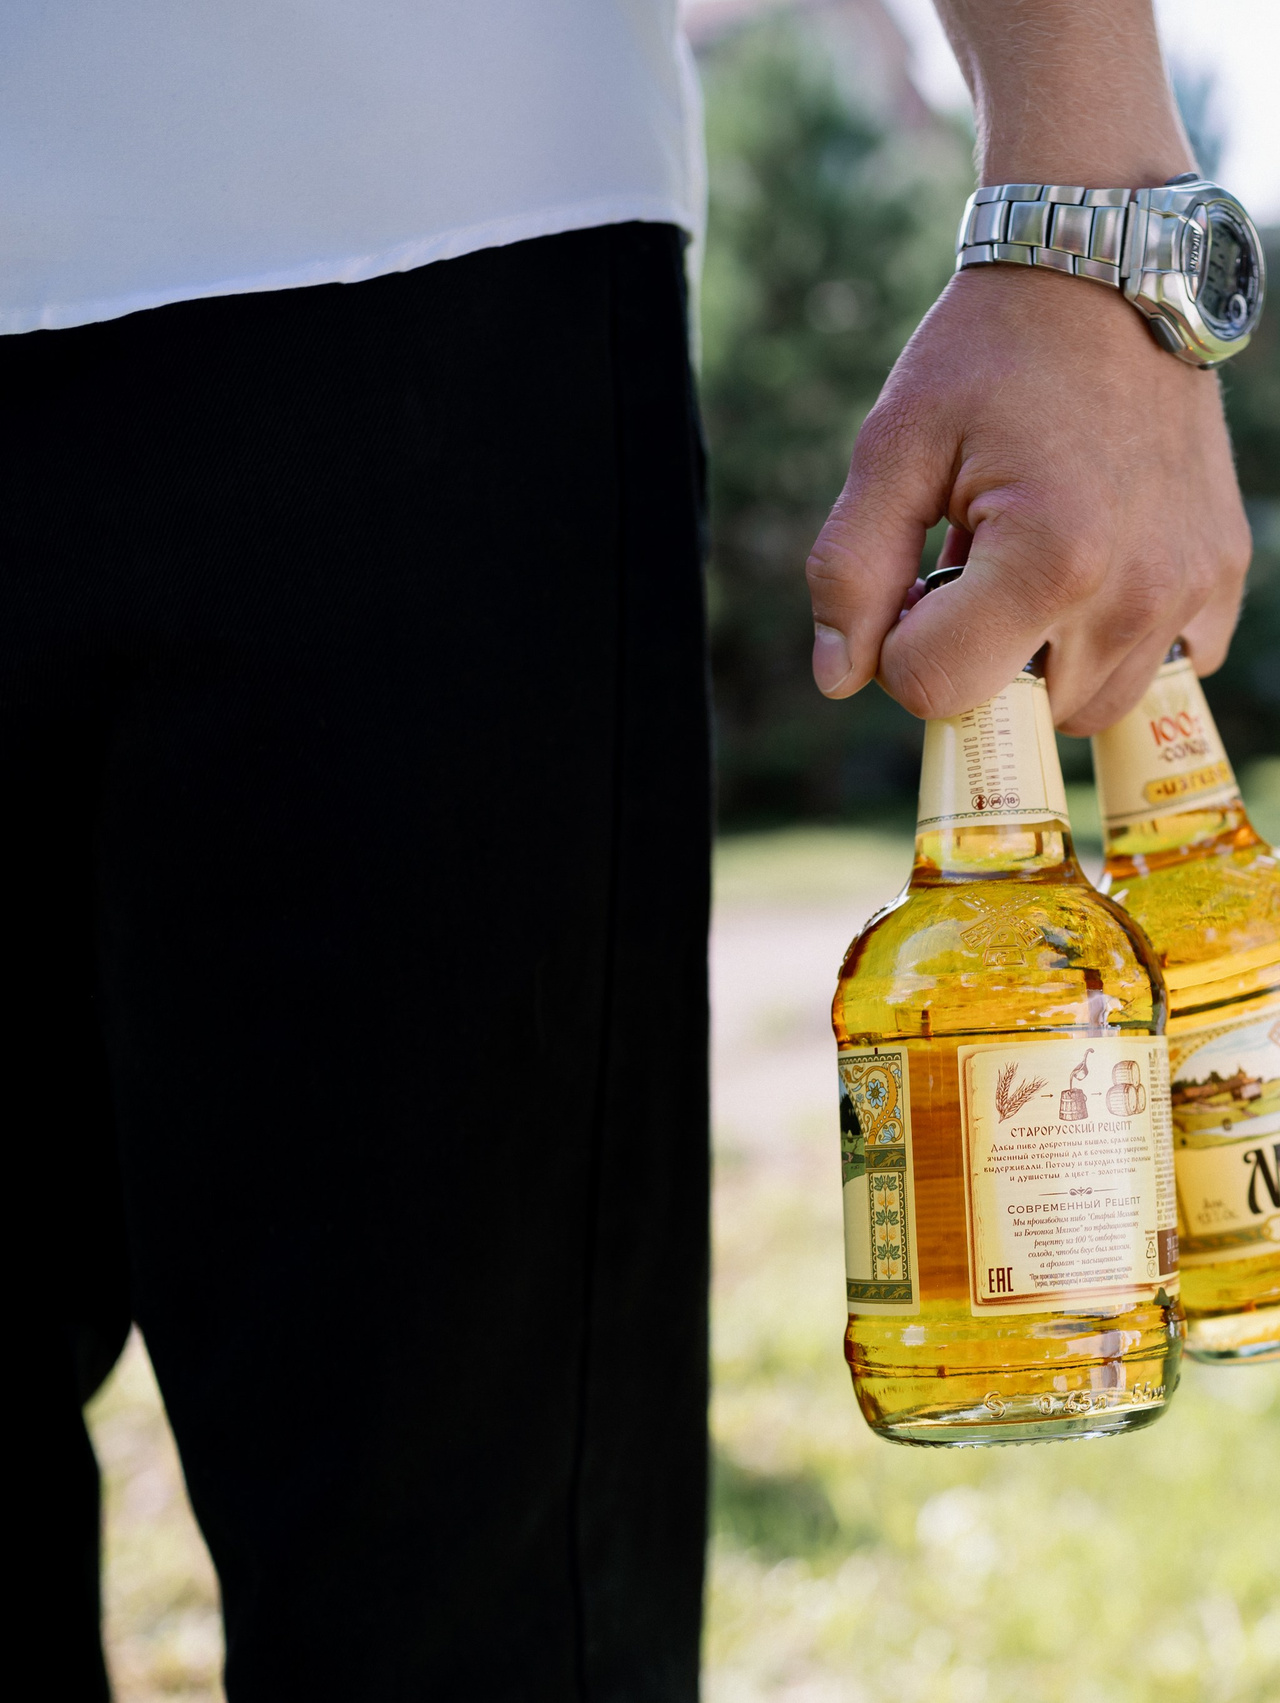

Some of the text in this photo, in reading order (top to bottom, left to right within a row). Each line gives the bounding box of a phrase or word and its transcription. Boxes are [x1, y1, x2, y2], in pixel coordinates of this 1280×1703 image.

[976, 699, 1001, 793] ТРЕБЛЕНИЕ ПИВА
[993, 695, 1019, 792] РЕЗМЕРНОЕ
[963, 736, 985, 795] ЗДОРОВЬЮ
[1010, 1120, 1132, 1138] СТАРОРУССКИЙ РЕЦЕПТ
[1039, 1140, 1082, 1150] добротным
[1130, 1135, 1146, 1143] солод
[986, 1152, 1029, 1162] ячменный
[1030, 1150, 1070, 1160] отборный
[1072, 1150, 1082, 1158] да
[1045, 1160, 1076, 1169] Потому
[1084, 1158, 1115, 1167] выходил
[1116, 1157, 1130, 1165] вкус
[1071, 1171, 1089, 1179] цвет
[1012, 1218, 1026, 1227] Мы
[1024, 1228, 1054, 1237] Бочонка
[1033, 1238, 1064, 1249] рецепту
[1075, 1234, 1086, 1243] 100
